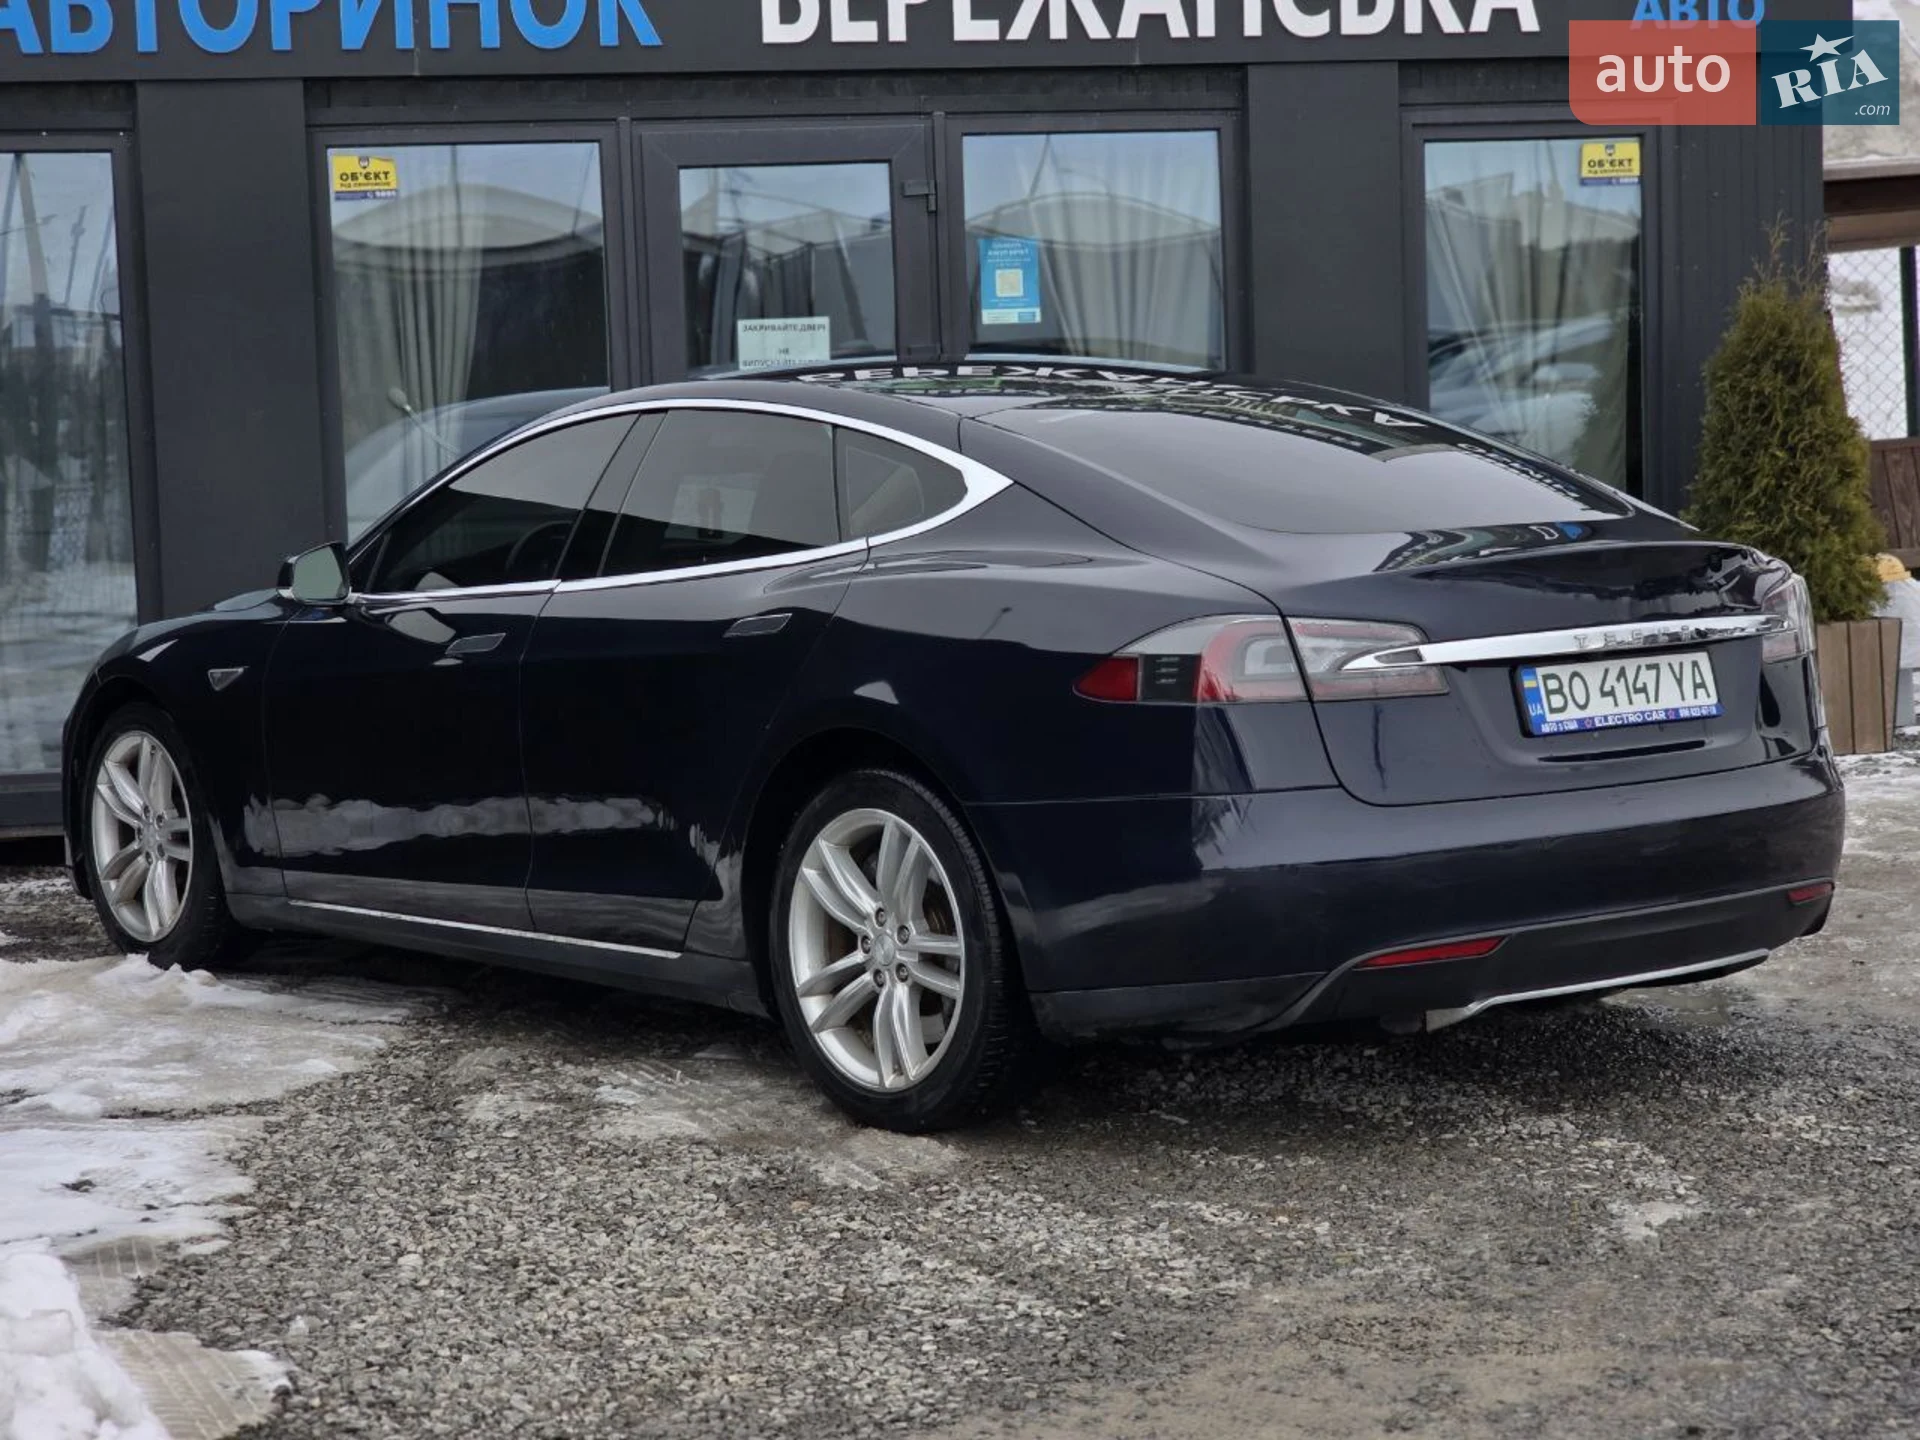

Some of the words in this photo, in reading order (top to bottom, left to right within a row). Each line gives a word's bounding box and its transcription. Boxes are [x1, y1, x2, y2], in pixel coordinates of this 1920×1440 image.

[340, 170, 391, 182] ОБ'ЄКТ
[1541, 670, 1591, 715] BO
[1599, 662, 1661, 708] 4147
[1667, 659, 1711, 702] YA
[1527, 703, 1545, 717] UA
[1594, 711, 1644, 728] ELECTRO
[1645, 709, 1667, 721] CAR
